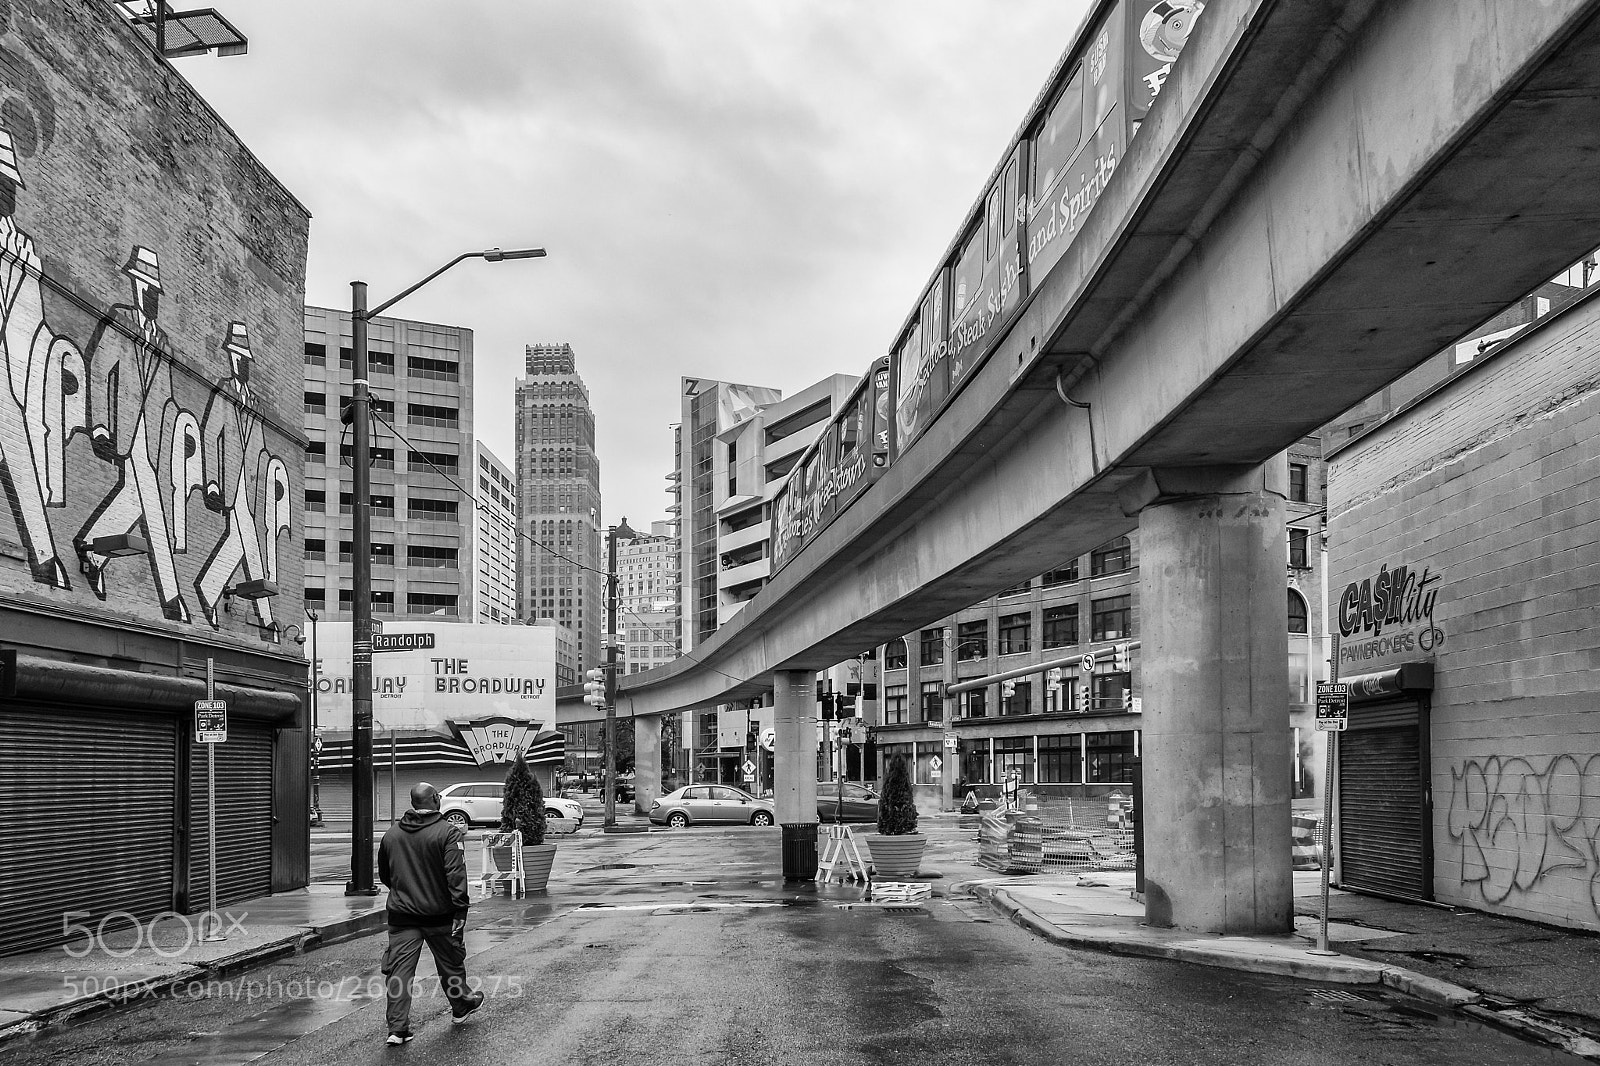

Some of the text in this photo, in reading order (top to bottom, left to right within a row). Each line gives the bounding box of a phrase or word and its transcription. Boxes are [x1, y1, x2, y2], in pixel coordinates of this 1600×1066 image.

[957, 310, 986, 353] Steak
[988, 242, 1023, 327] Sushi
[1028, 201, 1057, 265] and
[1059, 143, 1117, 236] Spirits
[685, 379, 700, 396] Z
[1400, 565, 1444, 652] City
[376, 634, 432, 648] Randolph
[1340, 631, 1415, 664] PAWNBROKERS
[430, 657, 468, 675] THE
[435, 677, 545, 694] BROADWAY
[1317, 684, 1333, 693] ZONE
[1334, 684, 1346, 693] 103
[197, 701, 225, 709] ZONE 103
[492, 730, 509, 738] THE
[473, 742, 527, 755] BROADWAY
